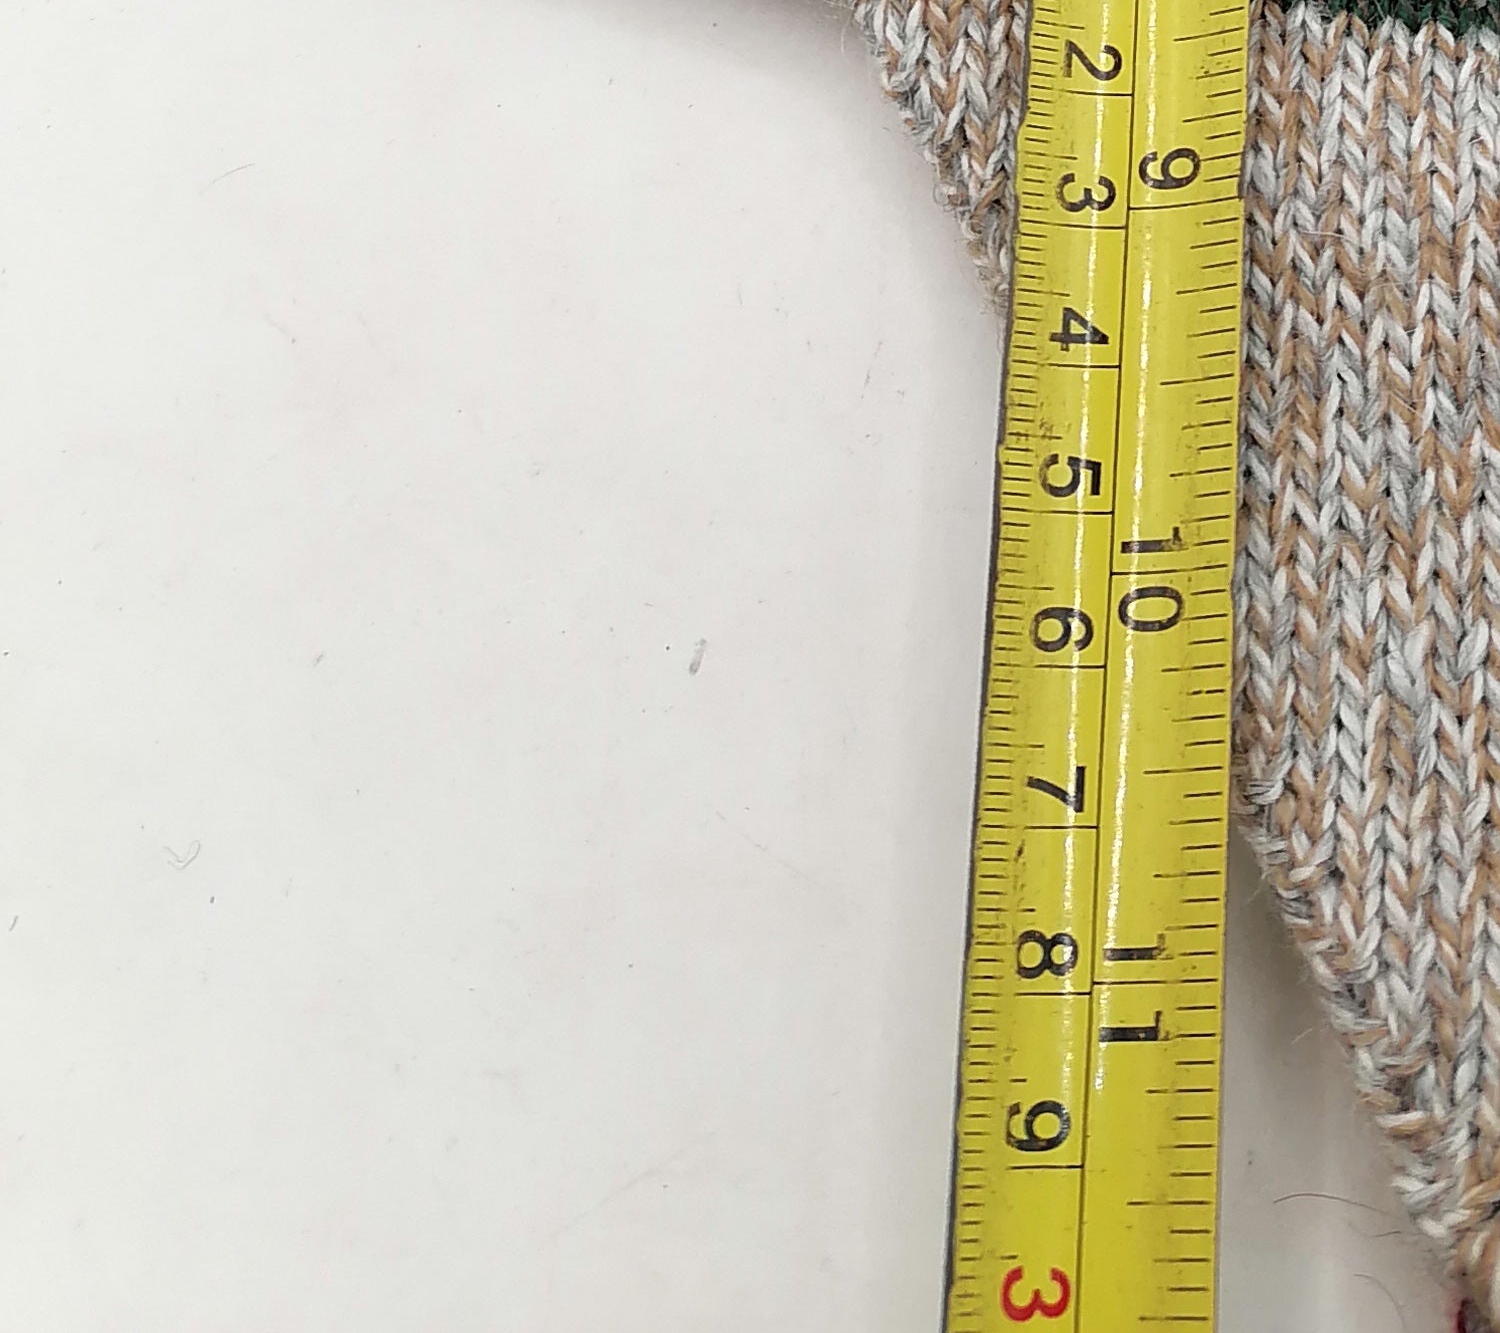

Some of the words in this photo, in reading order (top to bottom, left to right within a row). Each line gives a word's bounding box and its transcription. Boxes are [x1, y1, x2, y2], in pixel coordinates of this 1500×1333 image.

[1063, 39, 1123, 82] 2
[1055, 172, 1117, 213] 3
[1138, 146, 1201, 190] 9
[1049, 306, 1109, 352] 4
[1039, 453, 1102, 498] 5
[1120, 526, 1184, 633] 10
[1029, 605, 1094, 654] 6
[1026, 765, 1086, 814] 7
[1016, 929, 1079, 979] 8
[1099, 933, 1173, 1042] 11
[1005, 1100, 1071, 1152] 9
